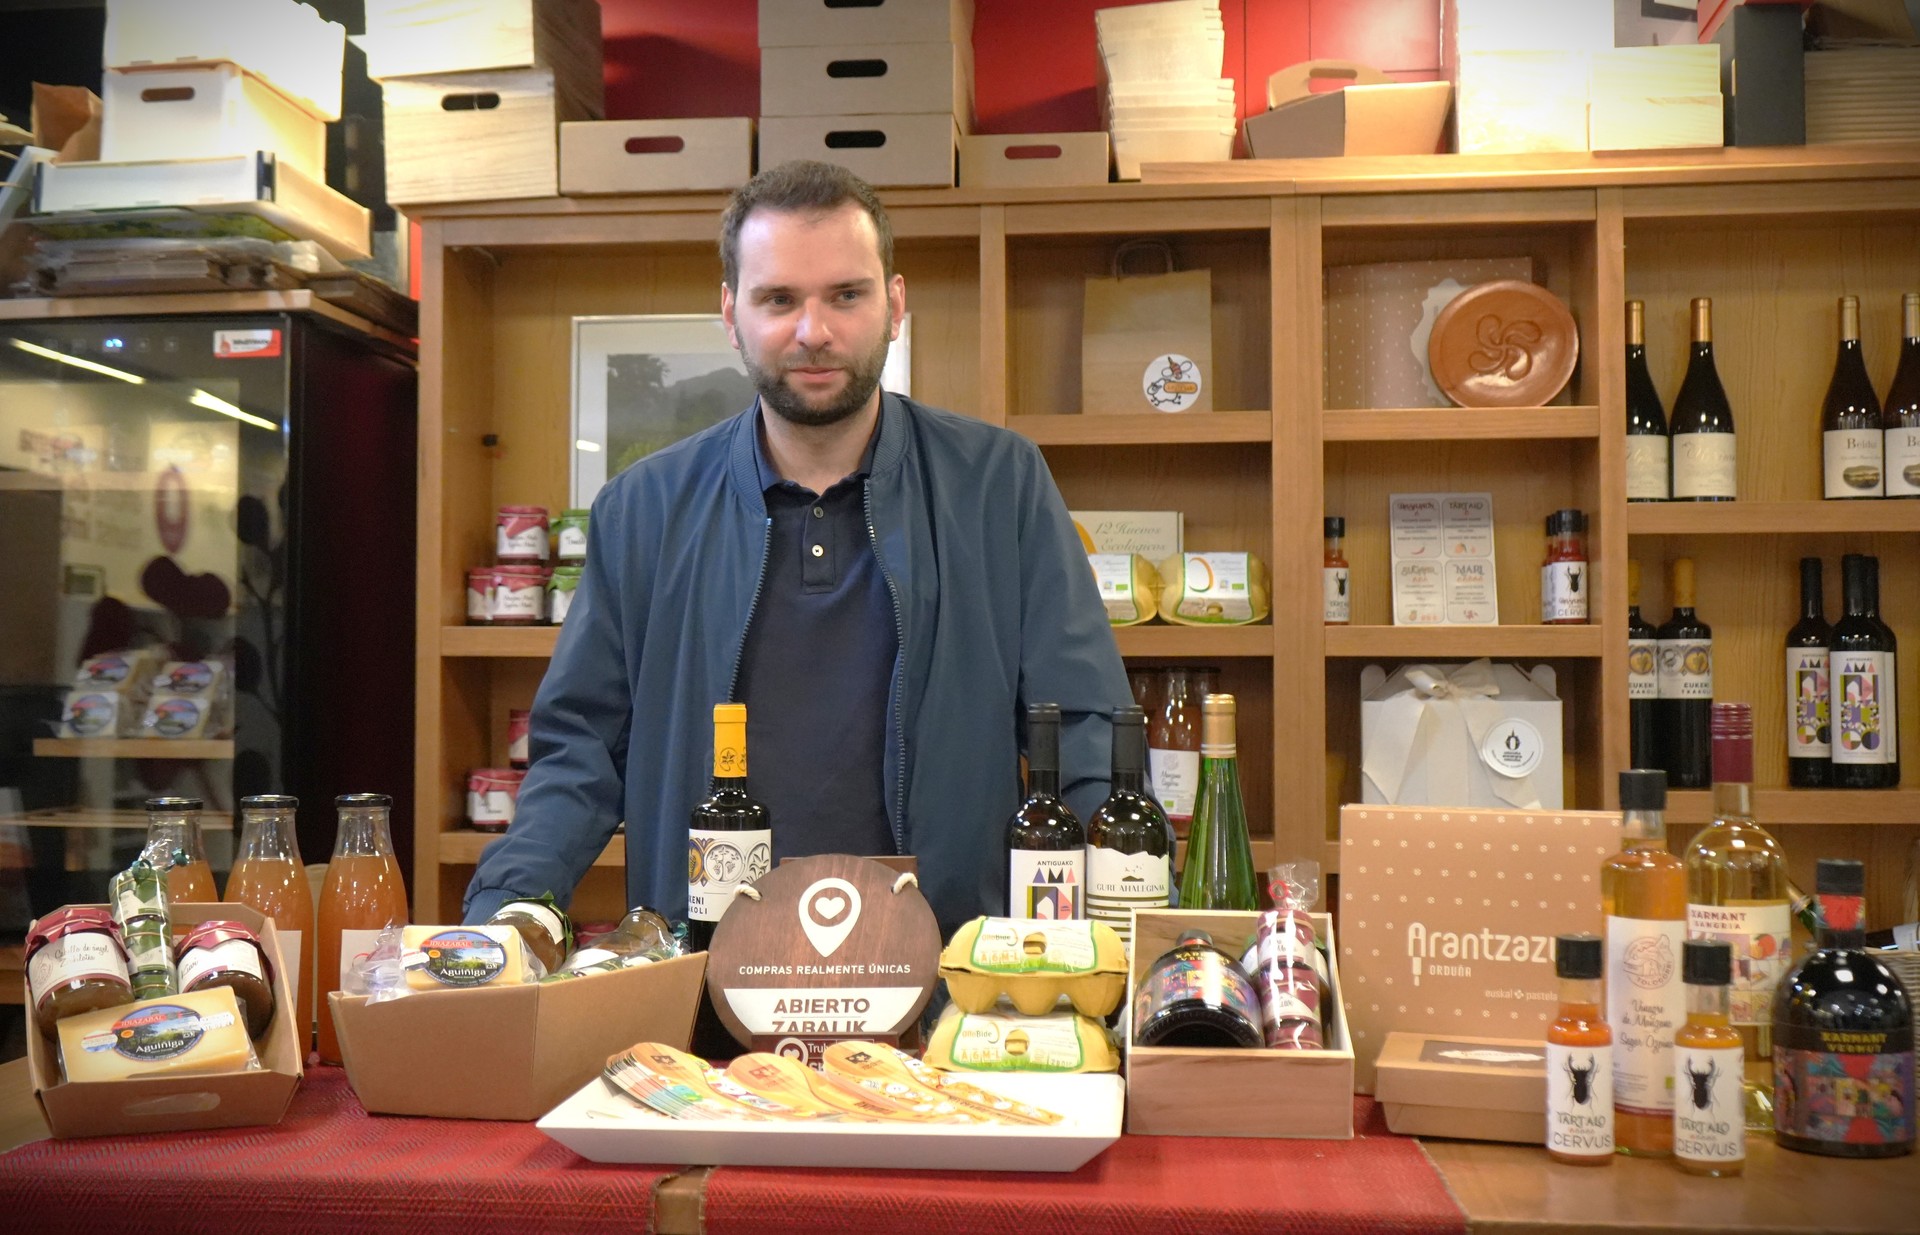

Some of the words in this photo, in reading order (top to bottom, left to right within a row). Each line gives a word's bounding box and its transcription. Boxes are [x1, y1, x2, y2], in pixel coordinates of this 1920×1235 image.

[1096, 521, 1113, 534] 12
[1843, 662, 1876, 673] AMA
[1032, 867, 1076, 884] AMA
[1096, 883, 1116, 892] GURE
[440, 968, 487, 977] Aguiñiga
[739, 965, 793, 975] COMPRAS
[796, 964, 865, 975] REALMENTE
[868, 963, 911, 974] ÚNICAS
[1429, 964, 1472, 978] ORDUÑA
[1485, 989, 1513, 999] euskal
[1526, 990, 1558, 1001] pastela
[773, 998, 870, 1014] ABIERTO
[135, 1039, 185, 1054] Aguiñiga
[1553, 1131, 1612, 1149] CERVUS
[1676, 1137, 1737, 1157] CERVUS
